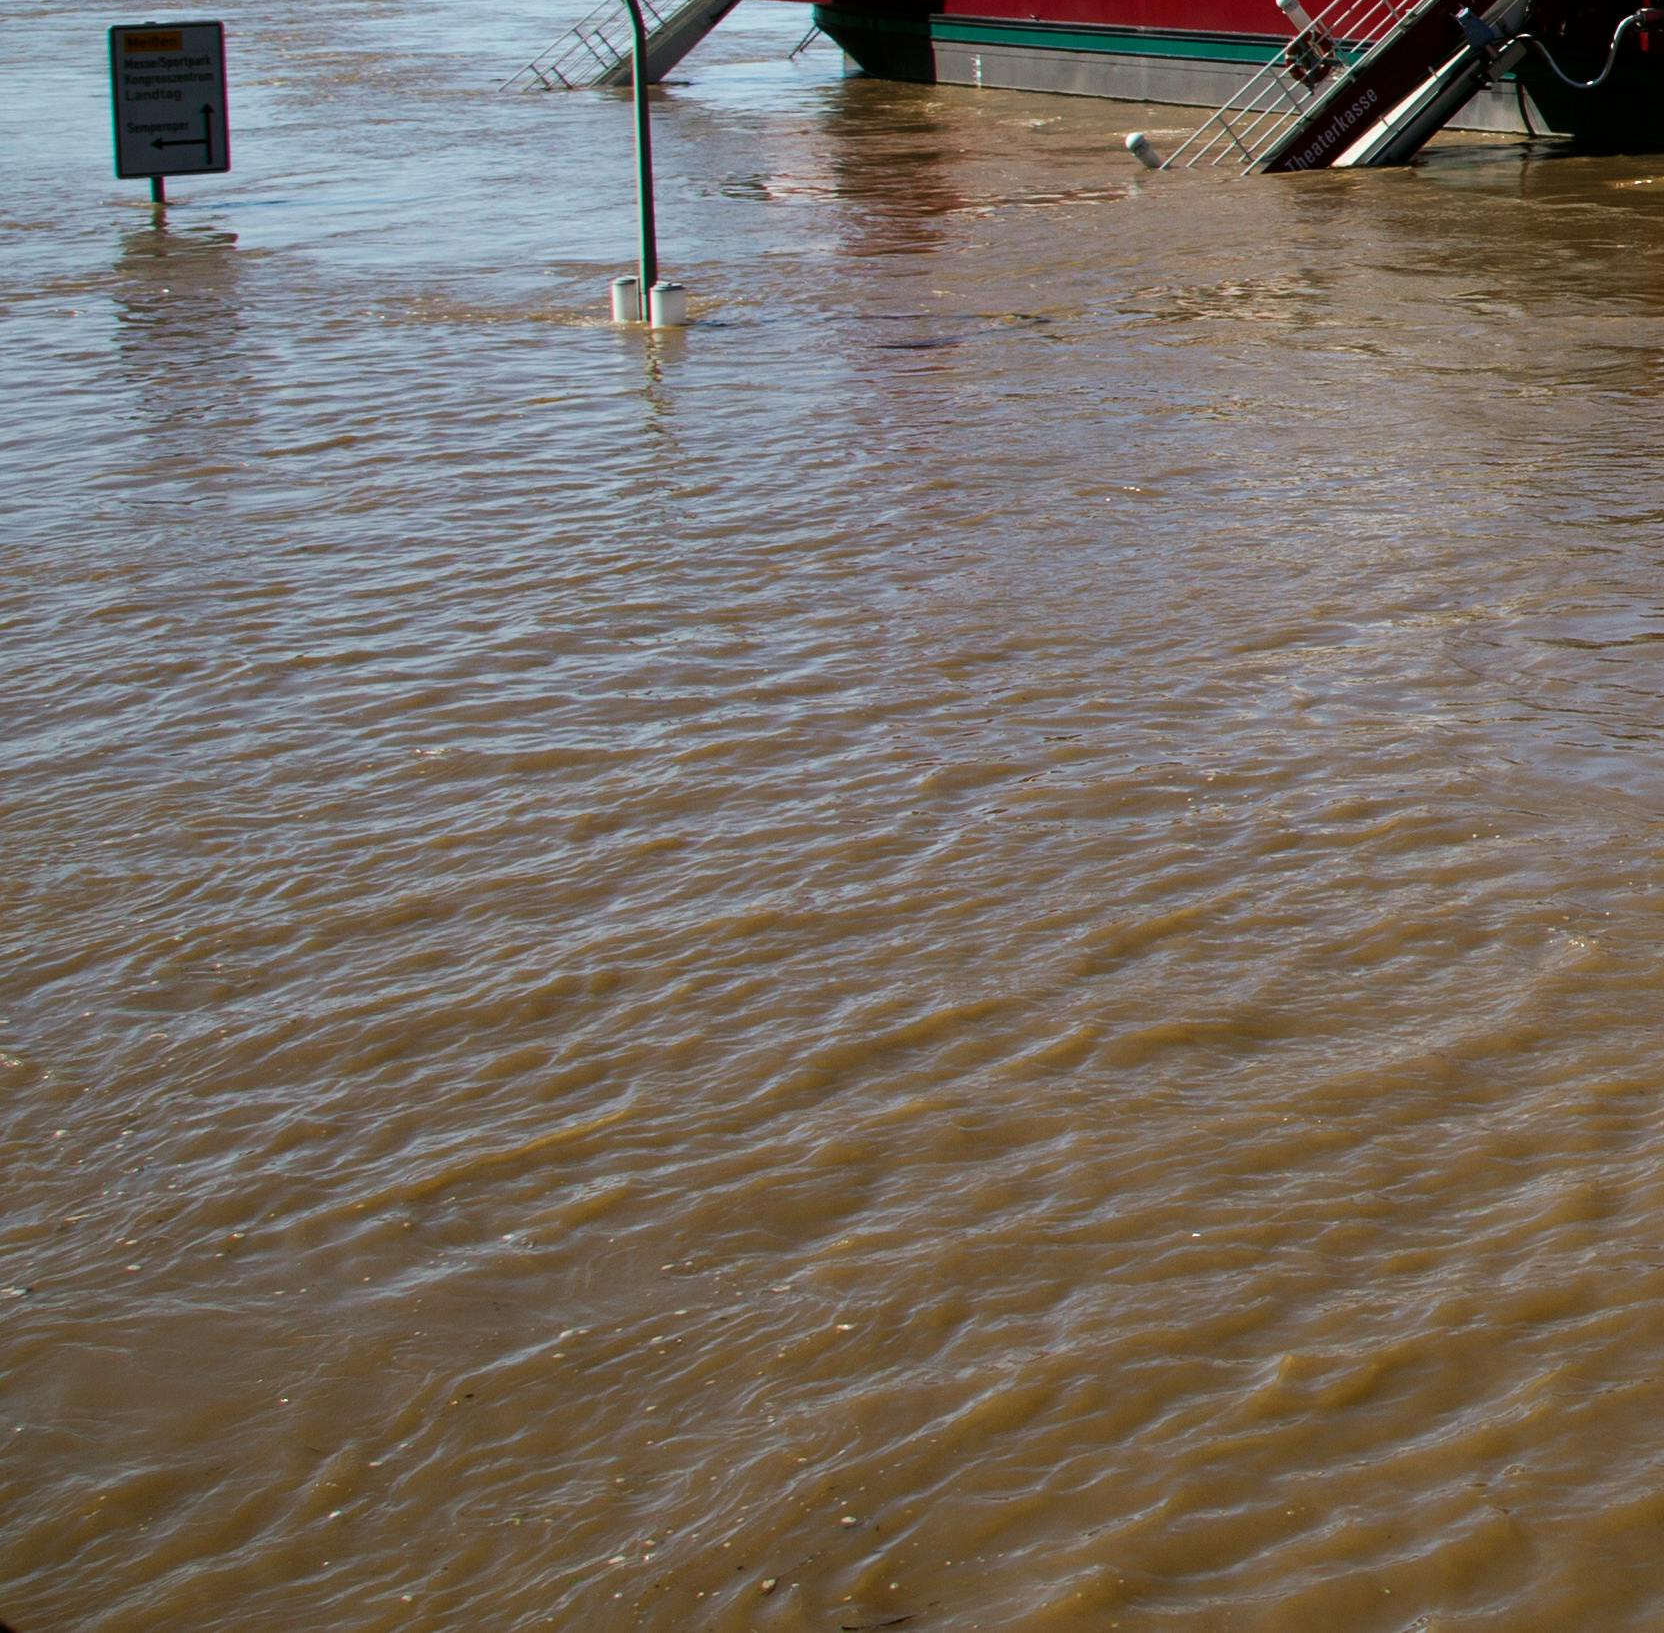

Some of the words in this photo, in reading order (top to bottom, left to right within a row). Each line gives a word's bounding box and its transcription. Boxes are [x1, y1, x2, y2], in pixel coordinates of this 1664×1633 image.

[125, 88, 182, 102] Landtag
[127, 122, 188, 134] Semperoper
[1285, 88, 1378, 171] Theaterkasse
